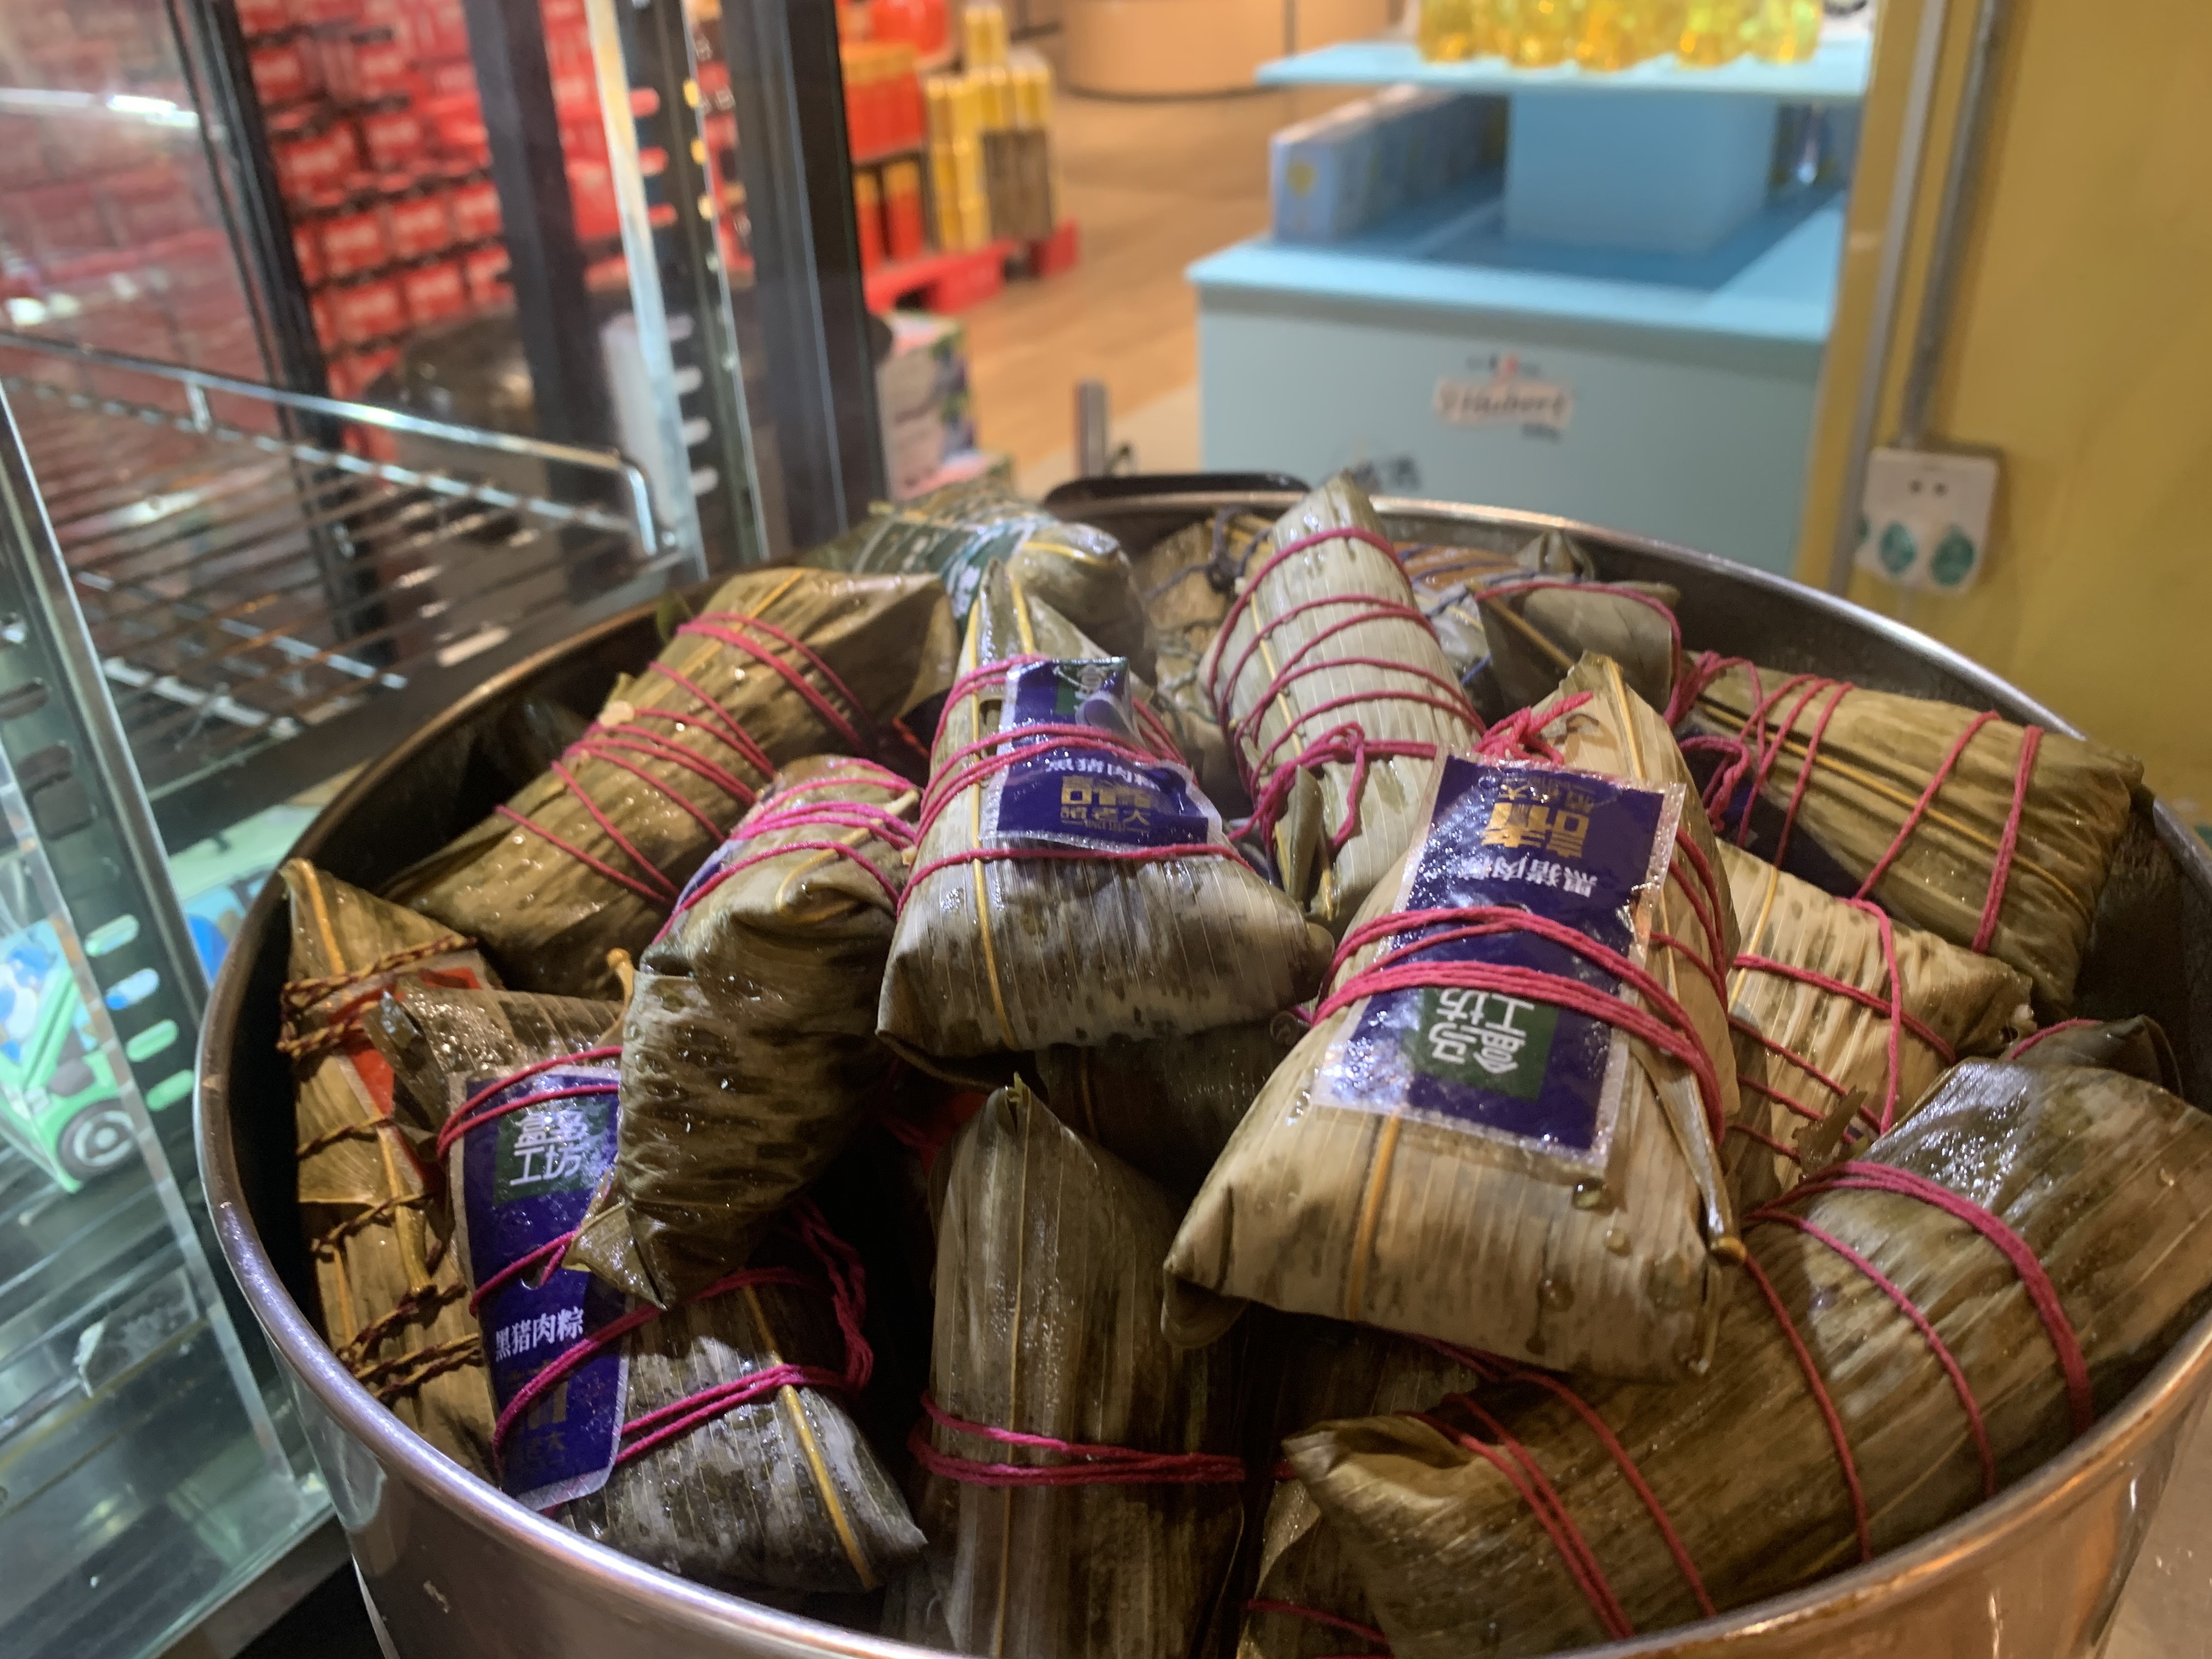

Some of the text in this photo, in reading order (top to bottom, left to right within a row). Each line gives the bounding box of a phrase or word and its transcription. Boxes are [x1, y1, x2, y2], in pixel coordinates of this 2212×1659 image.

[1437, 987, 1534, 1035] 工坊
[1428, 1022, 1526, 1074] 盒马
[510, 1144, 584, 1186] 工坊
[495, 1306, 584, 1362] 黑猪肉粽
